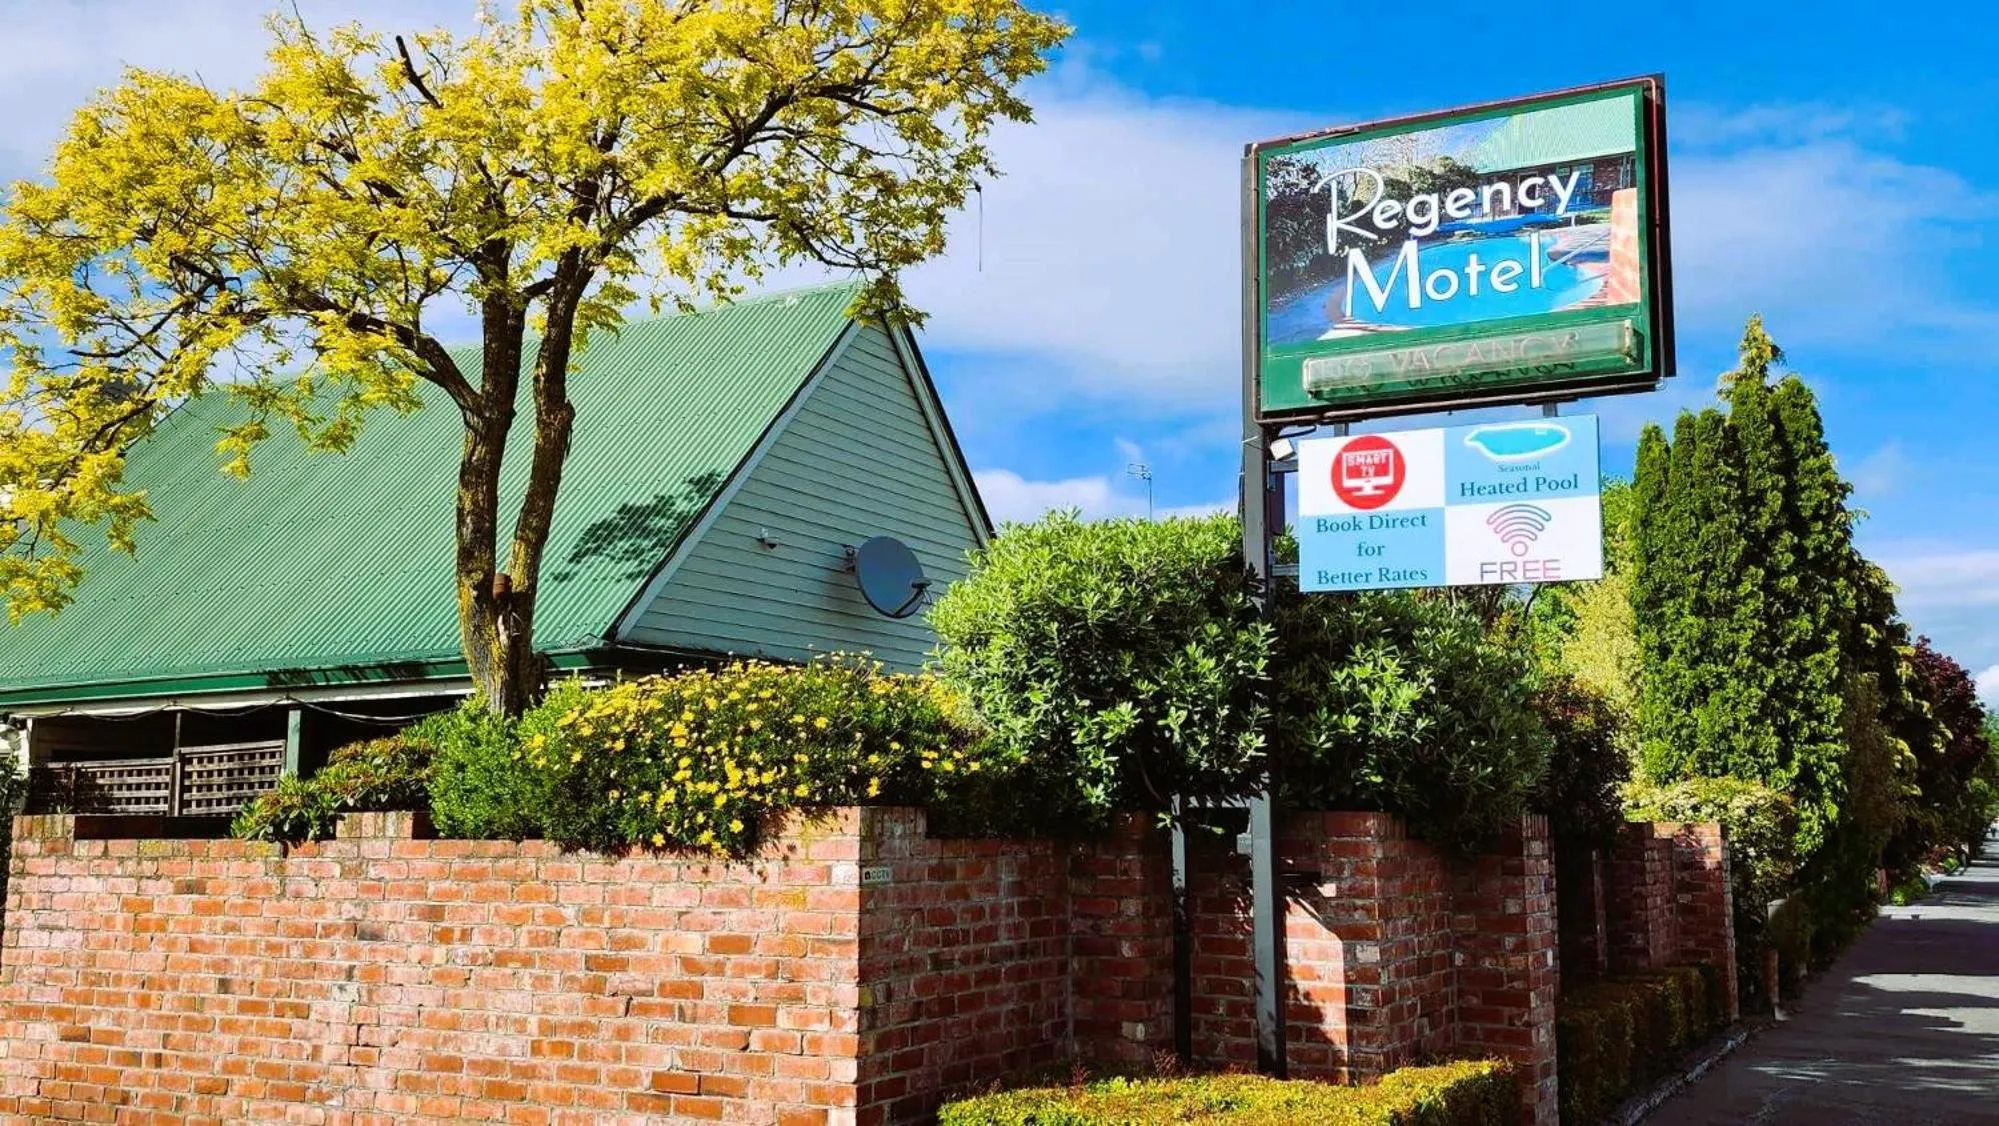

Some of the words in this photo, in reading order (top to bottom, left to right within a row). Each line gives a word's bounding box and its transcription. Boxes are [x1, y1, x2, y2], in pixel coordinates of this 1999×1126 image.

[1312, 167, 1581, 255] Regency
[1345, 232, 1543, 317] Motel
[1390, 332, 1581, 371] VACANCY
[1346, 451, 1389, 467] SMART
[1497, 462, 1541, 473] Seasonal
[1360, 466, 1377, 478] TV
[1460, 476, 1528, 497] Heated
[1535, 473, 1579, 493] Pool
[1316, 515, 1364, 533] Book
[1369, 513, 1427, 530] Direct
[1356, 541, 1385, 557] for
[1317, 568, 1373, 585] Better
[1378, 566, 1427, 582] Rates
[1480, 559, 1562, 582] FREE
